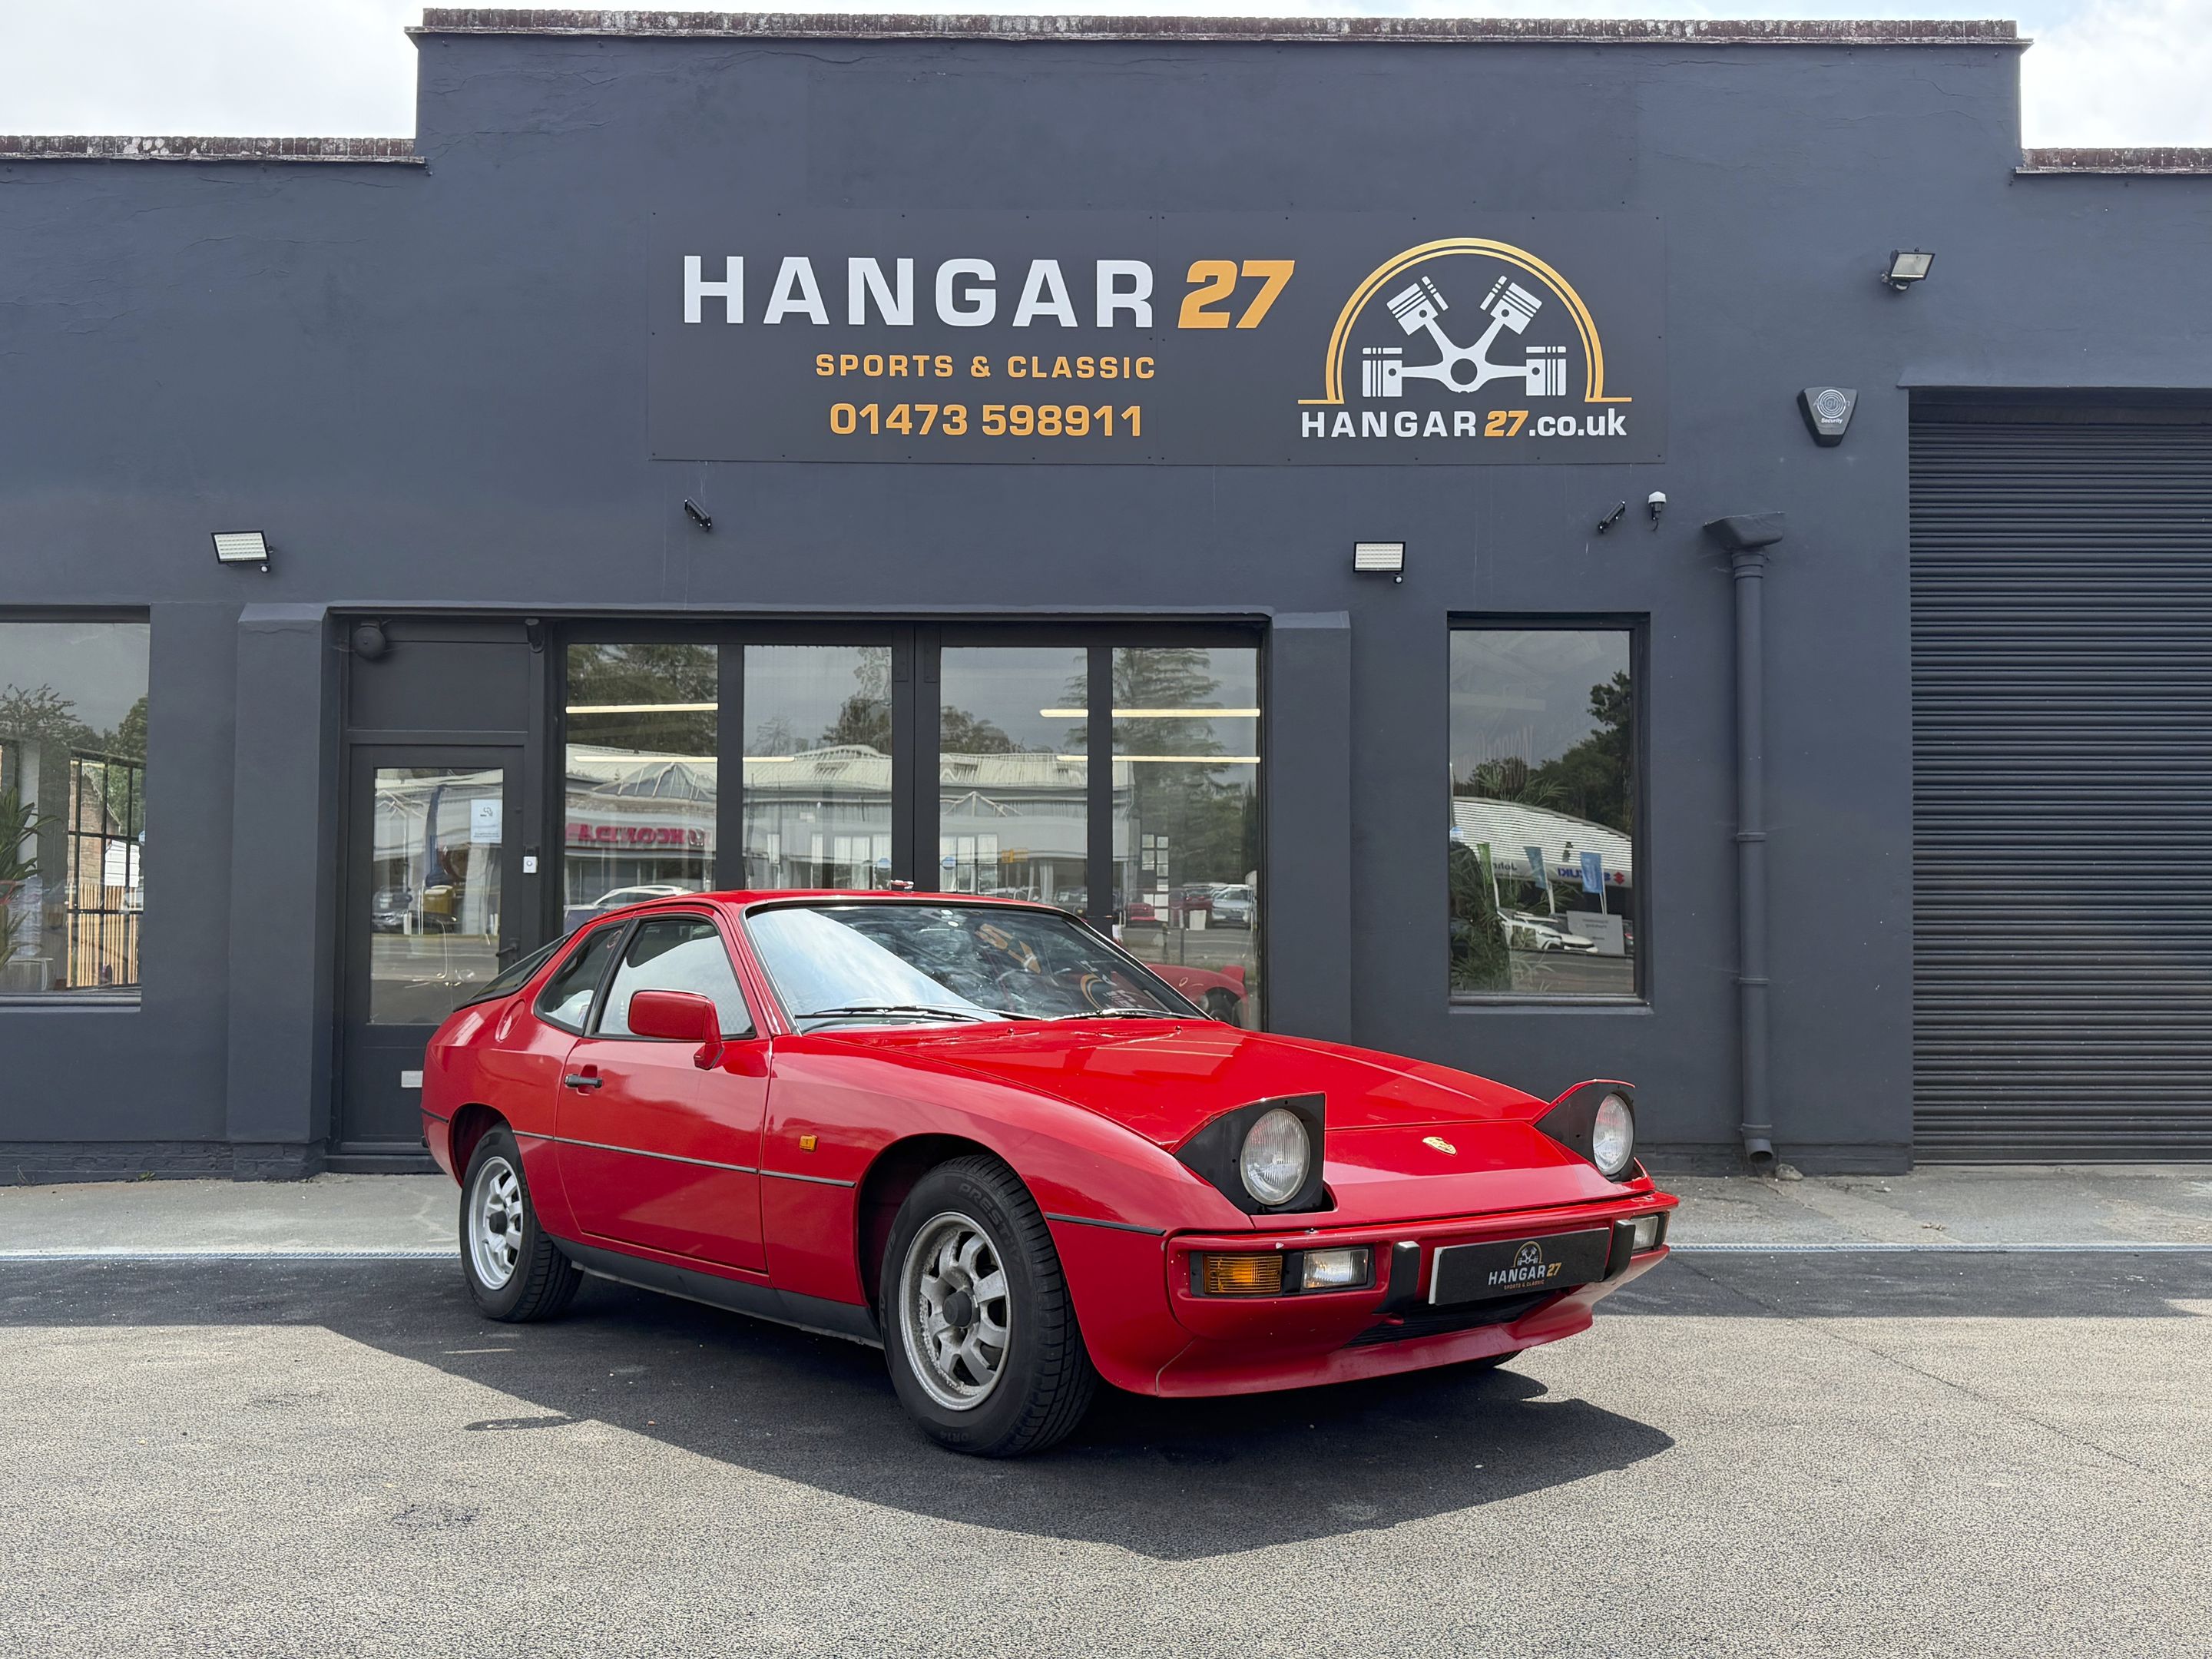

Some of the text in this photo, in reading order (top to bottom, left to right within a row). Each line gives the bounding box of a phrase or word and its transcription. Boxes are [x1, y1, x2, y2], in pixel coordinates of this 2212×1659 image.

[683, 255, 1296, 329] HANGAR 27
[816, 353, 1155, 379] SPORTS & CLASSIC
[830, 402, 1141, 437] 01473 598911
[1488, 1262, 1561, 1285] HANGAR 27
